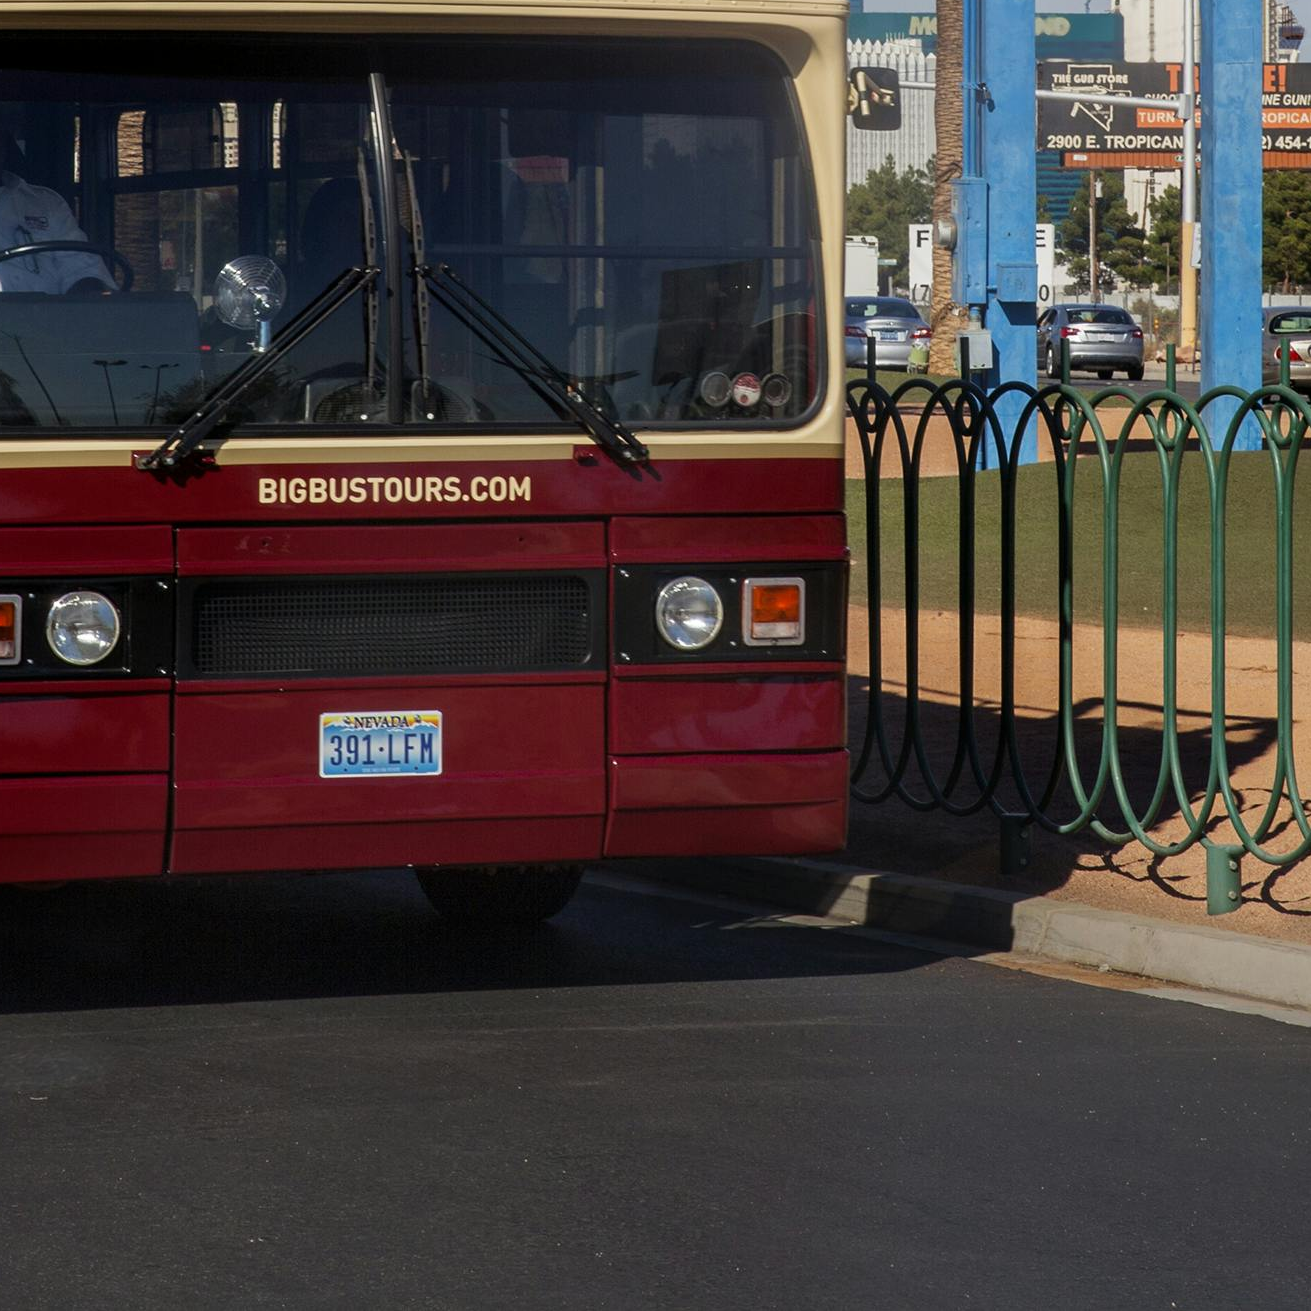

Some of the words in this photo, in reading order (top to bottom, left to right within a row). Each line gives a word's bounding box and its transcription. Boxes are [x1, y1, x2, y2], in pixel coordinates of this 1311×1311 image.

[1052, 74, 1071, 84] THE
[1073, 74, 1094, 84] GUN
[1096, 74, 1129, 84] STORE
[1282, 94, 1311, 106] GUN!
[1137, 111, 1176, 123] TURN
[1047, 135, 1081, 149] 2900
[1085, 135, 1101, 149] E.
[1104, 135, 1184, 149] TROPICAN
[258, 476, 531, 504] BIGBUSTOURS.COM
[353, 715, 410, 729] NEVADA
